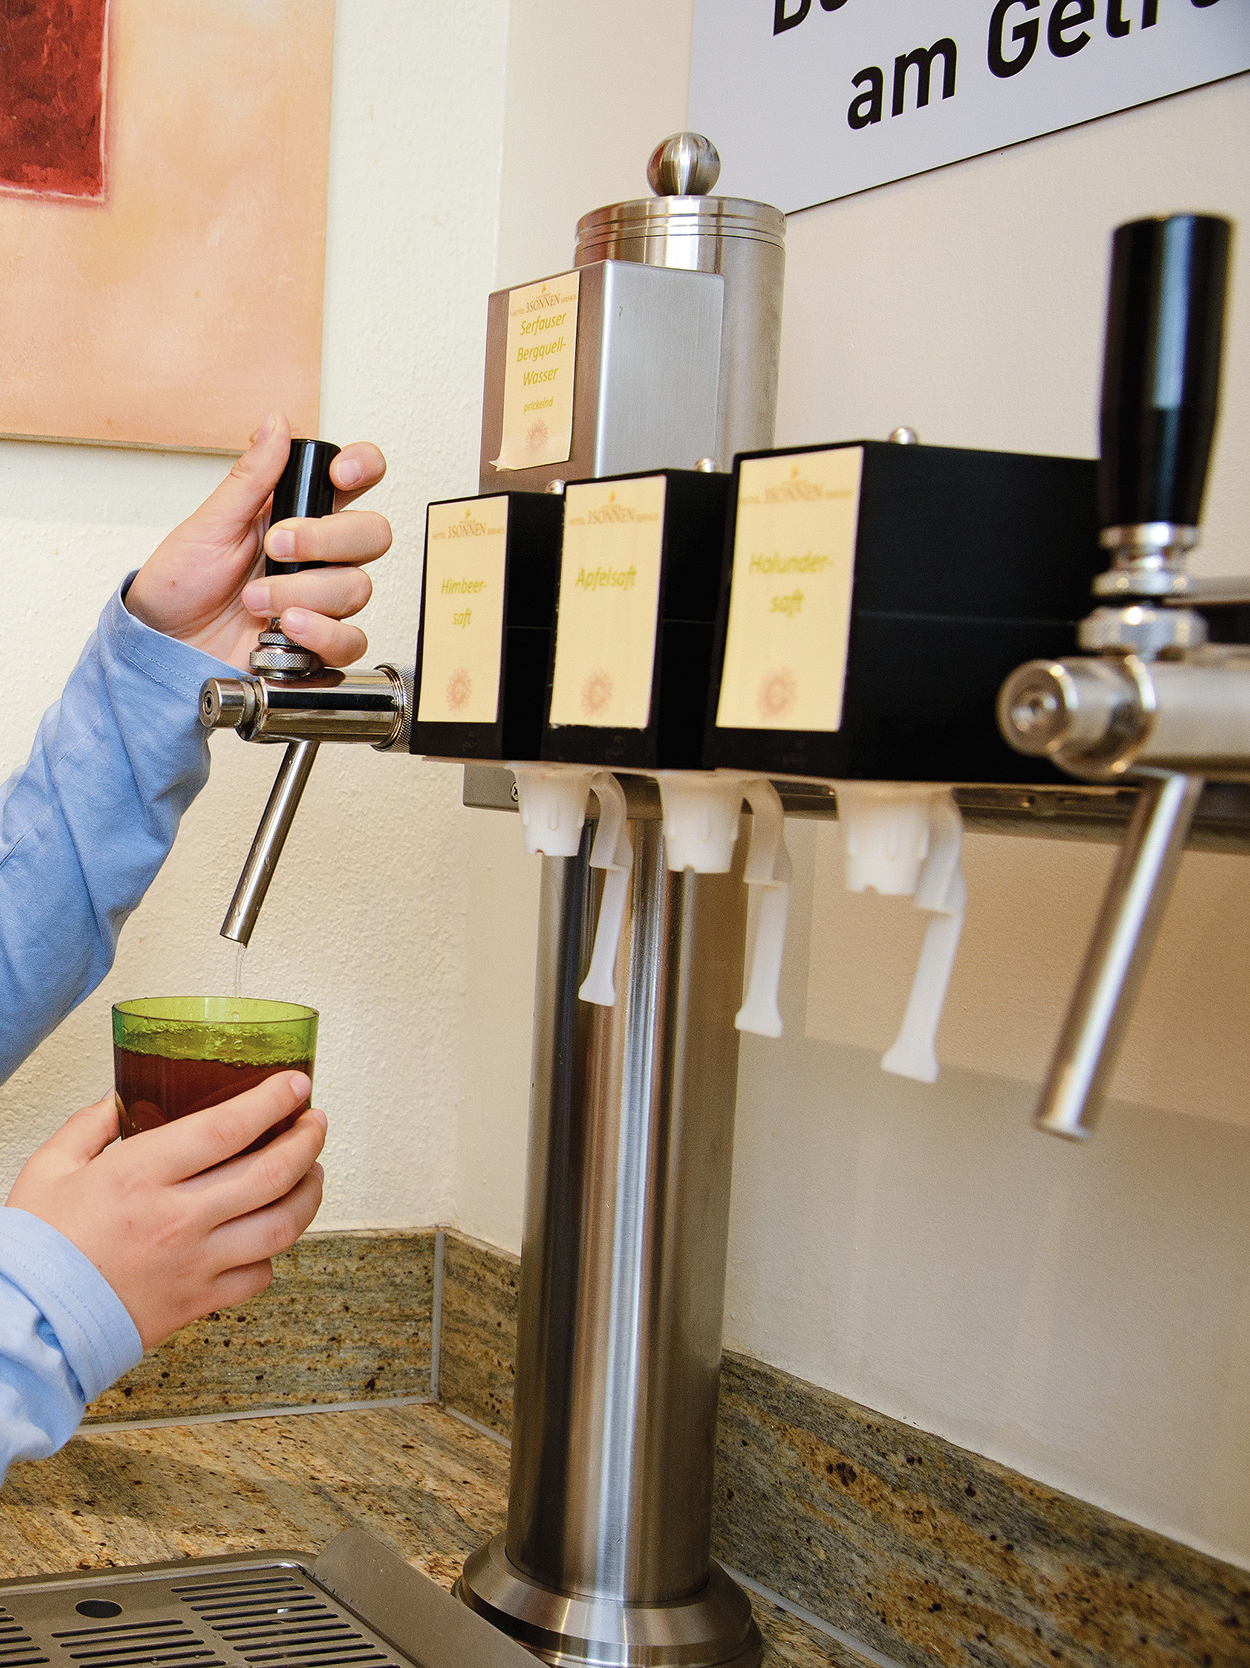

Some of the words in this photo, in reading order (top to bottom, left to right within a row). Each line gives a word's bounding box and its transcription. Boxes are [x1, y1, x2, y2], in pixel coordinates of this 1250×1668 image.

[847, 37, 958, 130] am
[987, 0, 1221, 79] Get
[520, 312, 567, 336] Serfauser
[516, 336, 567, 362] Bergquell-
[523, 367, 558, 386] Wasser
[441, 578, 487, 595] Himbeer-
[575, 565, 637, 592] Apfelsaft
[770, 588, 805, 618] saft
[452, 608, 472, 628] saft
